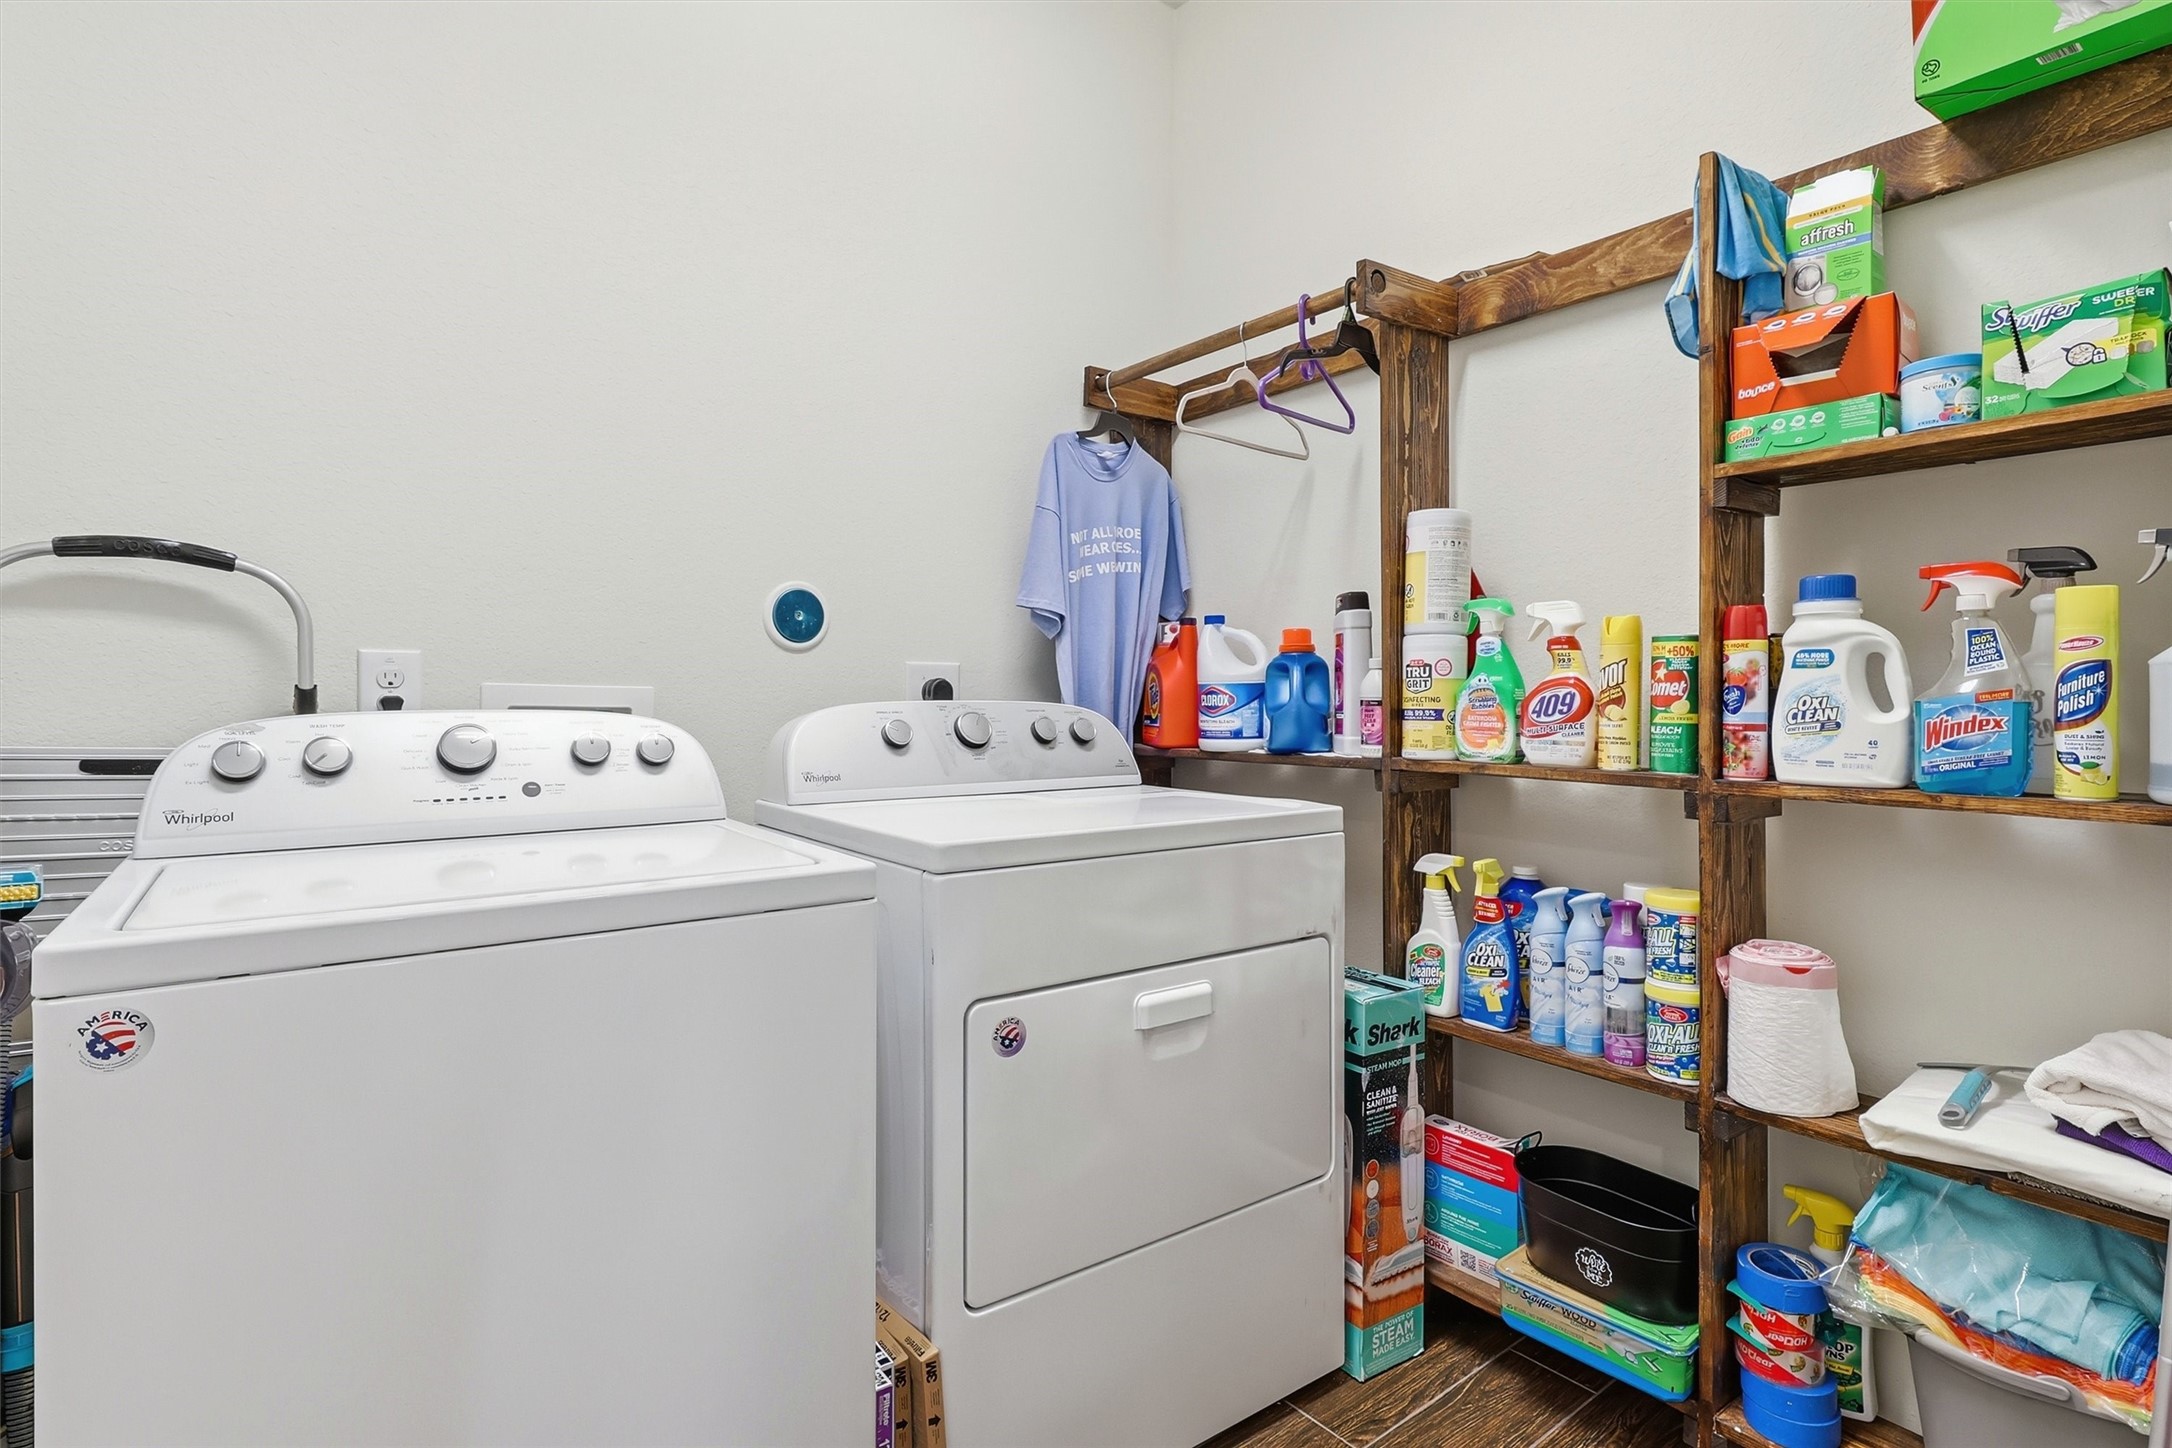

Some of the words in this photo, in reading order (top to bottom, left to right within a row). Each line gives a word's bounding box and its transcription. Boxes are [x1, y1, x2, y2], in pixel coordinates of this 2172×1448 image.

[1801, 218, 1854, 246] affresh
[2092, 284, 2155, 305] SWEEER
[2114, 296, 2136, 308] DR
[1738, 381, 1776, 400] bounce
[1985, 394, 1999, 405] 32
[1728, 426, 1754, 444] Gain
[1091, 526, 1113, 539] ALL
[1068, 565, 1093, 583] SE
[1970, 641, 1996, 651] OCEAN
[1971, 634, 1994, 645] 100%
[1667, 645, 1694, 656] +50%
[1970, 648, 1997, 658] BOUND
[1968, 653, 2000, 665] PLASTIC
[1406, 667, 1430, 678] TRU
[1406, 679, 1429, 689] GRIT
[2058, 670, 2105, 699] Furniture
[1200, 694, 1231, 706] CLOROX
[1468, 697, 1498, 705] Scrubbing
[1531, 690, 1577, 719] 409
[1798, 695, 1829, 711] OXI
[2057, 690, 2094, 718] Polish
[1786, 705, 1840, 725] CLEAN
[1526, 722, 1585, 735] MULTI-SURFACE
[1925, 714, 2010, 753] Windex
[1939, 761, 1976, 772] ORIGINAL
[804, 773, 841, 783] Whirlpool
[163, 811, 234, 826] Whirlpool
[1476, 942, 1497, 956] OXI
[1468, 952, 1505, 967] CLEAN
[1411, 963, 1442, 978] Cleaner
[77, 1010, 149, 1037] AMERICA
[993, 1017, 1020, 1041] AMERICA
[1367, 1016, 1421, 1047] Shark
[1647, 1024, 1700, 1044] OXI-ALL
[1367, 1060, 1388, 1074] STEAM
[1388, 1058, 1402, 1070] MOP
[1366, 1086, 1391, 1101] CLEAN
[1391, 1085, 1397, 1094] &
[1366, 1093, 1398, 1109] SANITIZE
[1424, 1235, 1453, 1256] BORAX
[1520, 1289, 1557, 1311] Swiffer
[1561, 1307, 1597, 1328] WOOD
[1373, 1323, 1384, 1334] THE
[1384, 1315, 1406, 1329] POWER
[1406, 1311, 1414, 1320] OF
[1372, 1318, 1414, 1349] STEAM
[904, 1336, 925, 1357] Filtrete
[1373, 1342, 1394, 1358] MADE
[895, 1366, 907, 1388] 3M
[925, 1360, 938, 1384] 3M
[883, 1392, 891, 1426] Filtrete
